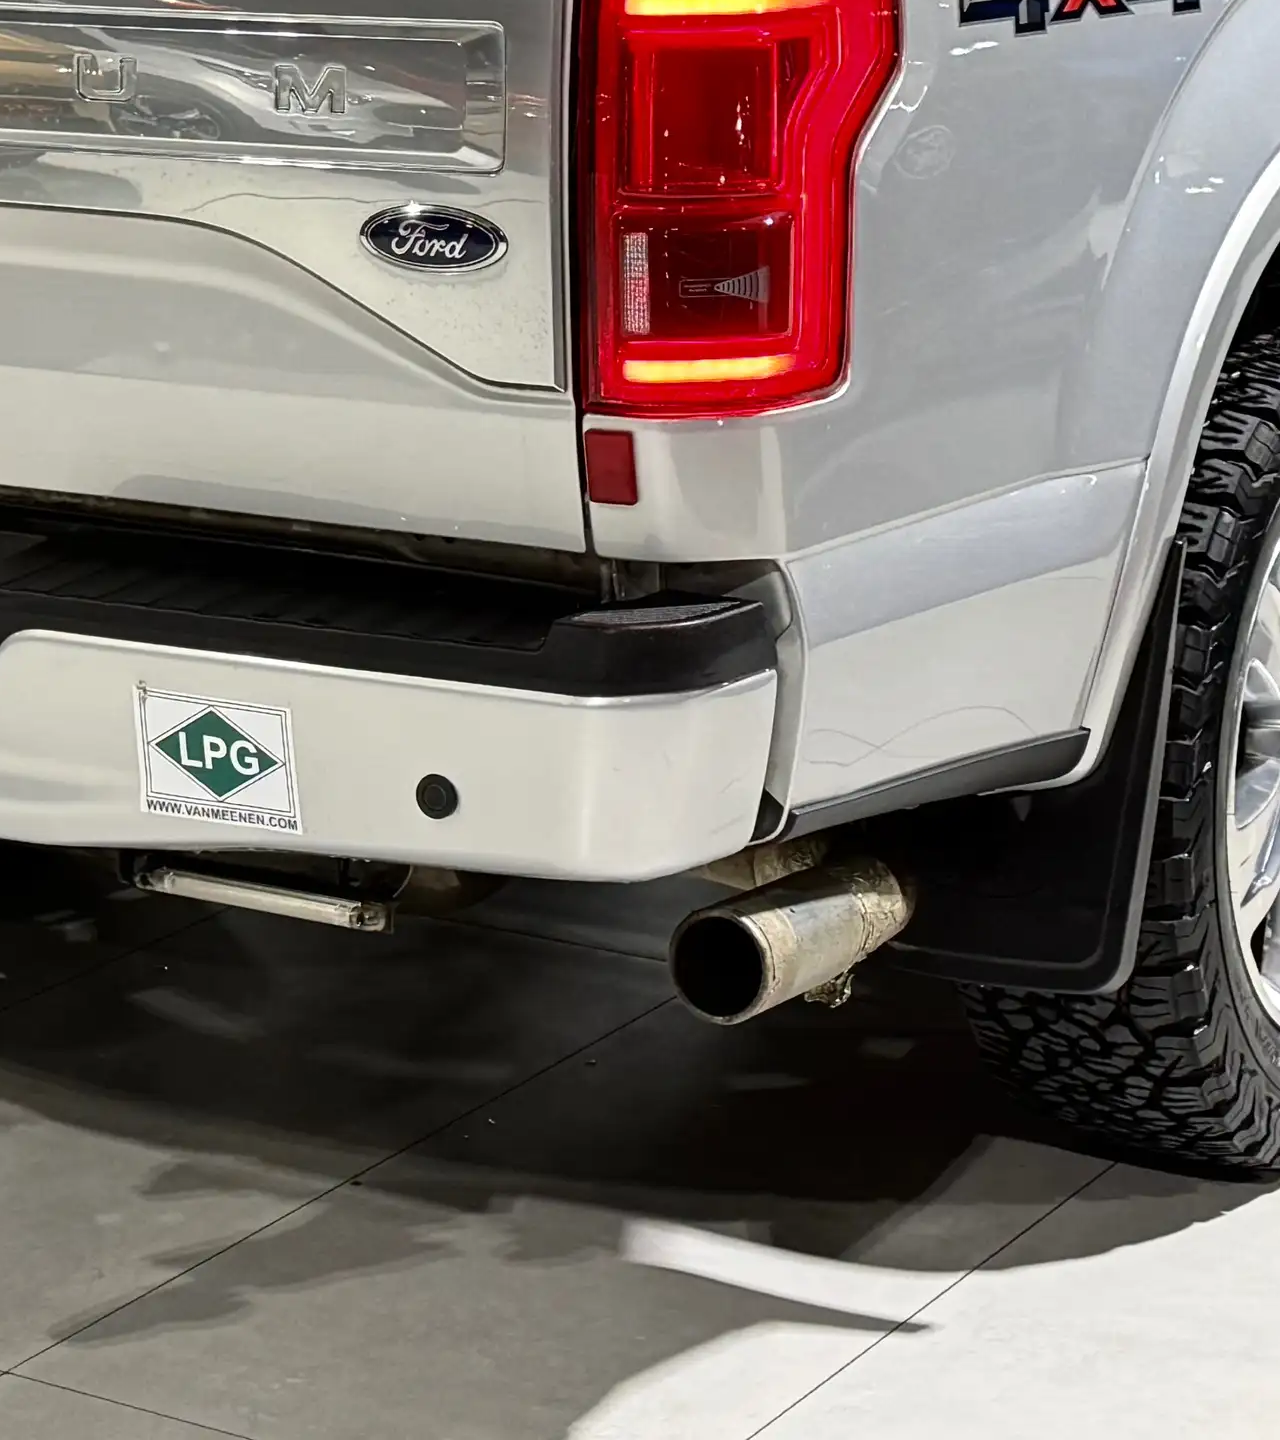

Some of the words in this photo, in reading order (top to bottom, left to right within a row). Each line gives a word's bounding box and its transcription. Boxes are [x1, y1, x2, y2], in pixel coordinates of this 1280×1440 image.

[391, 219, 468, 260] Ford
[178, 730, 261, 776] LPG
[147, 800, 298, 830] WWW.VANMEENEN.COM
